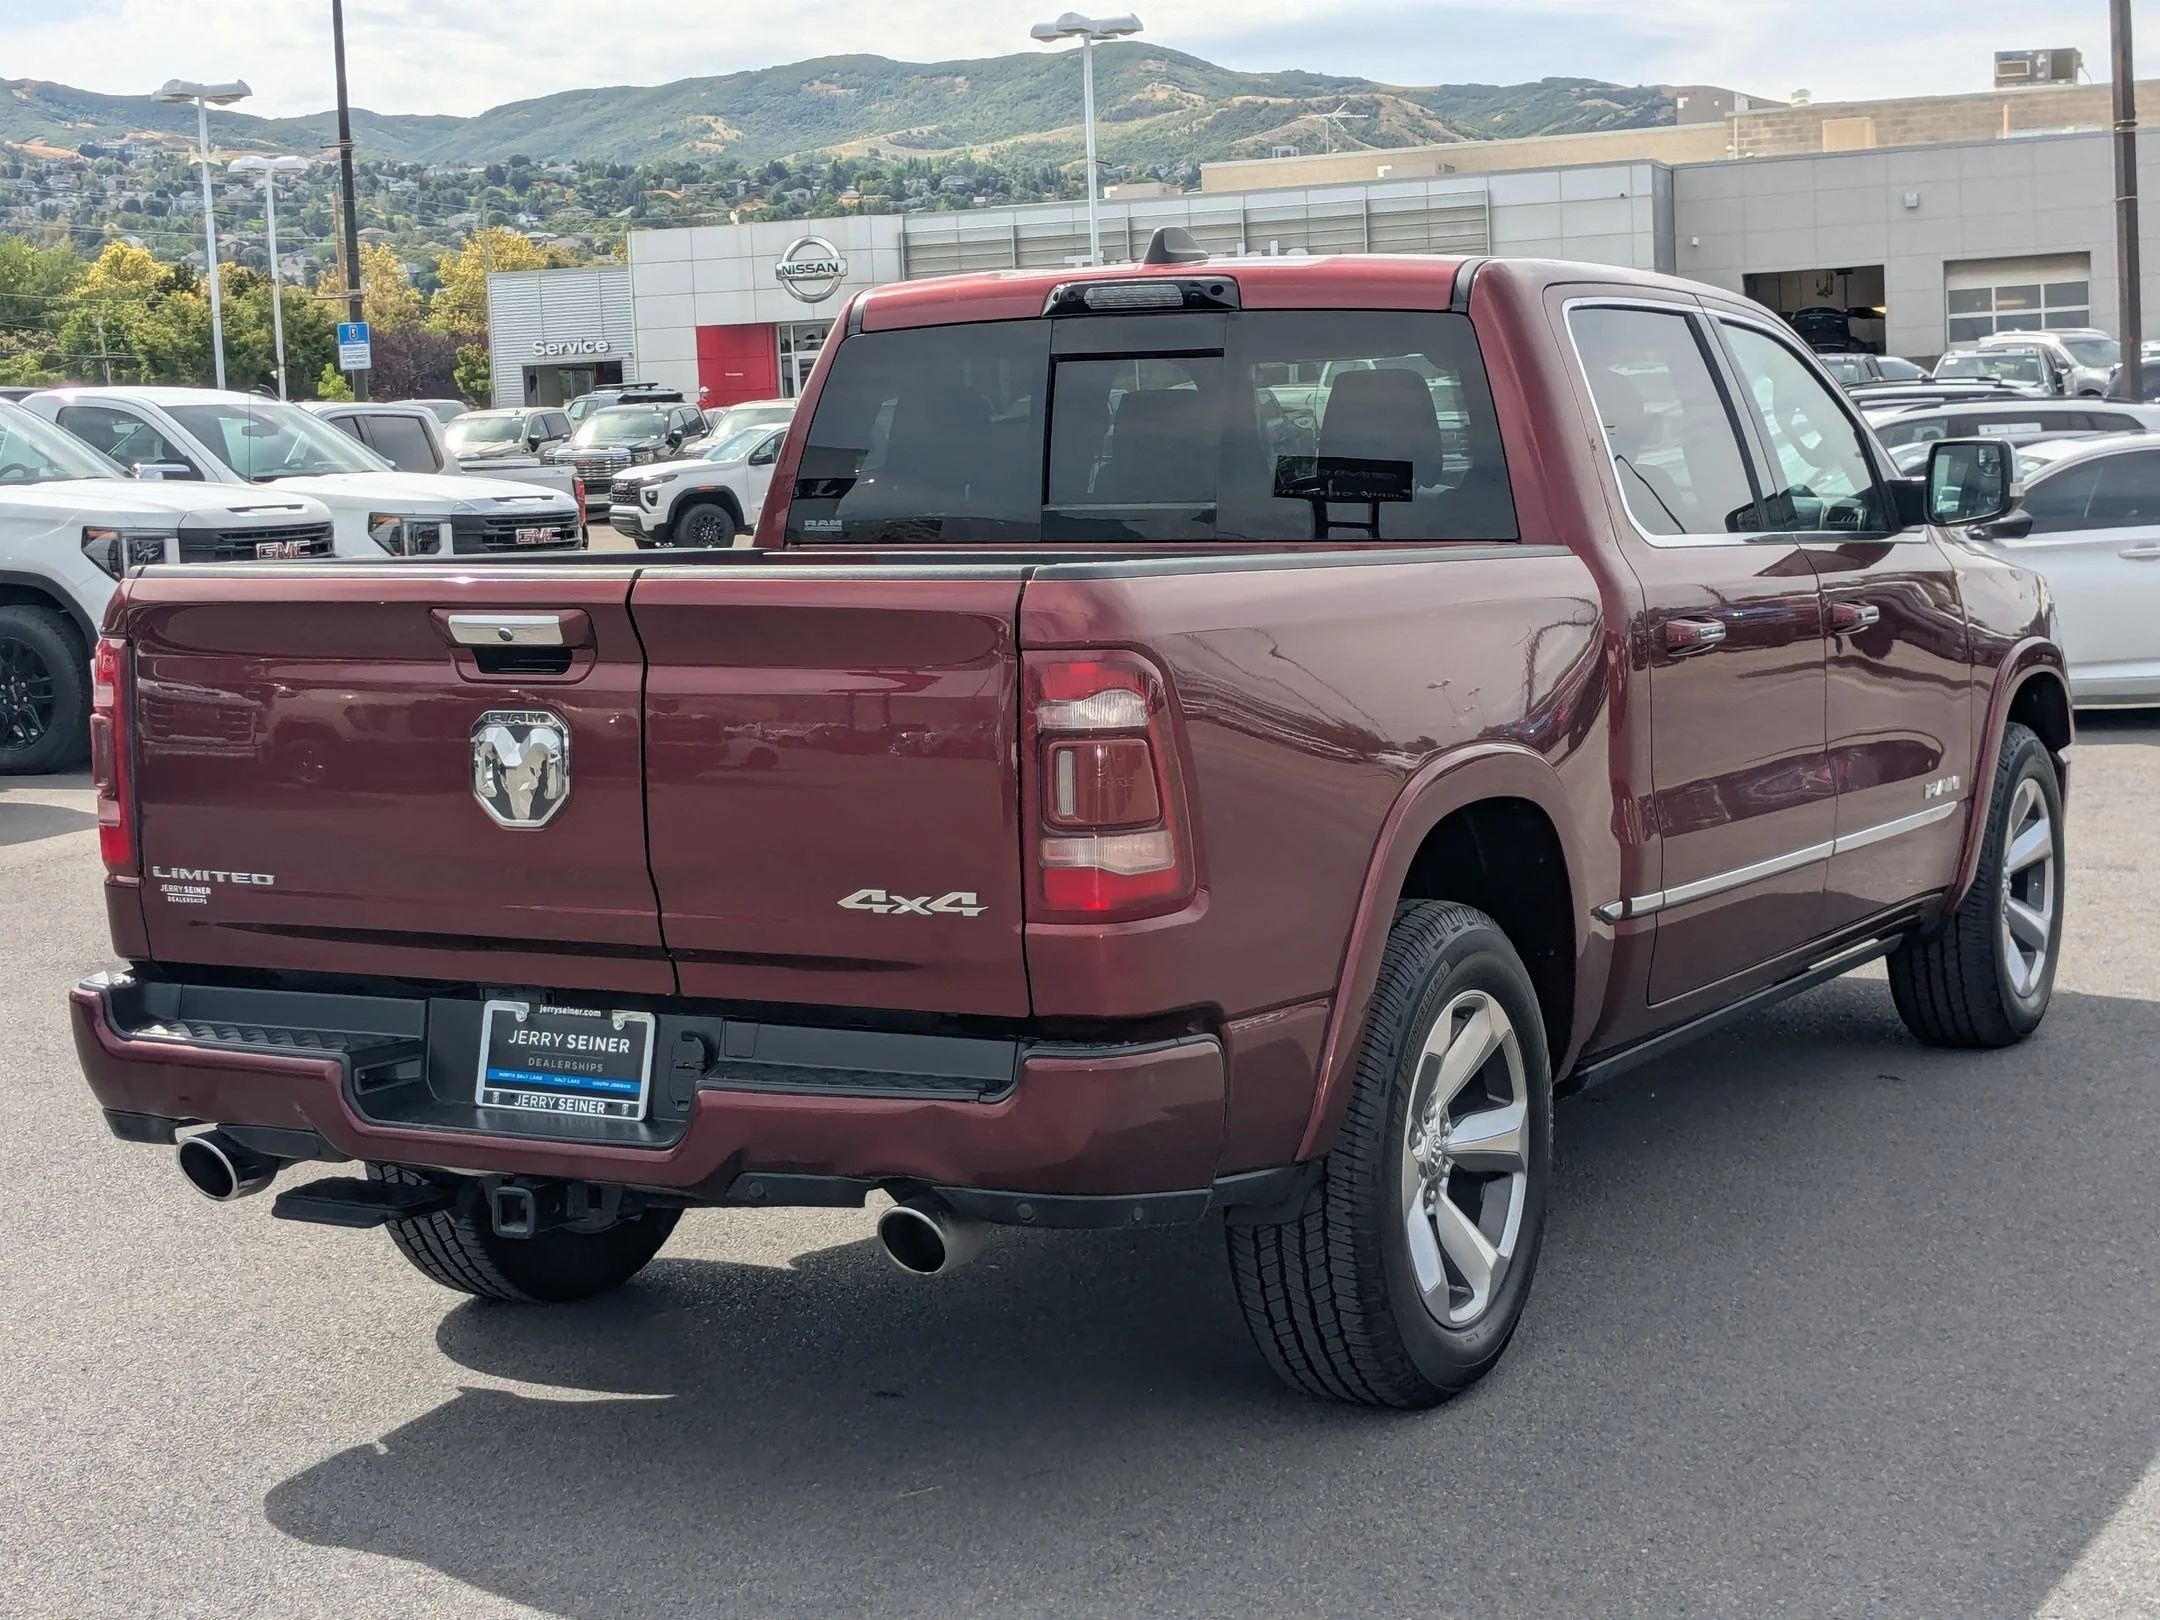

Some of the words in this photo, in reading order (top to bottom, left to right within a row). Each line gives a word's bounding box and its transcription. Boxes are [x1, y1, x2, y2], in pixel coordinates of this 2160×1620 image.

[782, 262, 839, 275] NISSAN
[532, 338, 610, 356] Service
[515, 527, 561, 544] GMC
[256, 540, 311, 560] GMC
[488, 713, 549, 725] RAM
[152, 866, 275, 885] LIMITED
[160, 884, 183, 893] JERRY
[183, 885, 212, 895] SEINER
[837, 889, 989, 916] 4x4
[539, 1004, 602, 1017] jerryseiner.com
[508, 1029, 564, 1047] JERRY
[566, 1034, 630, 1054] SEINER
[528, 1057, 604, 1073] DEALERSHIPS
[514, 1094, 556, 1109] JERRY
[558, 1098, 606, 1114] SEINER
